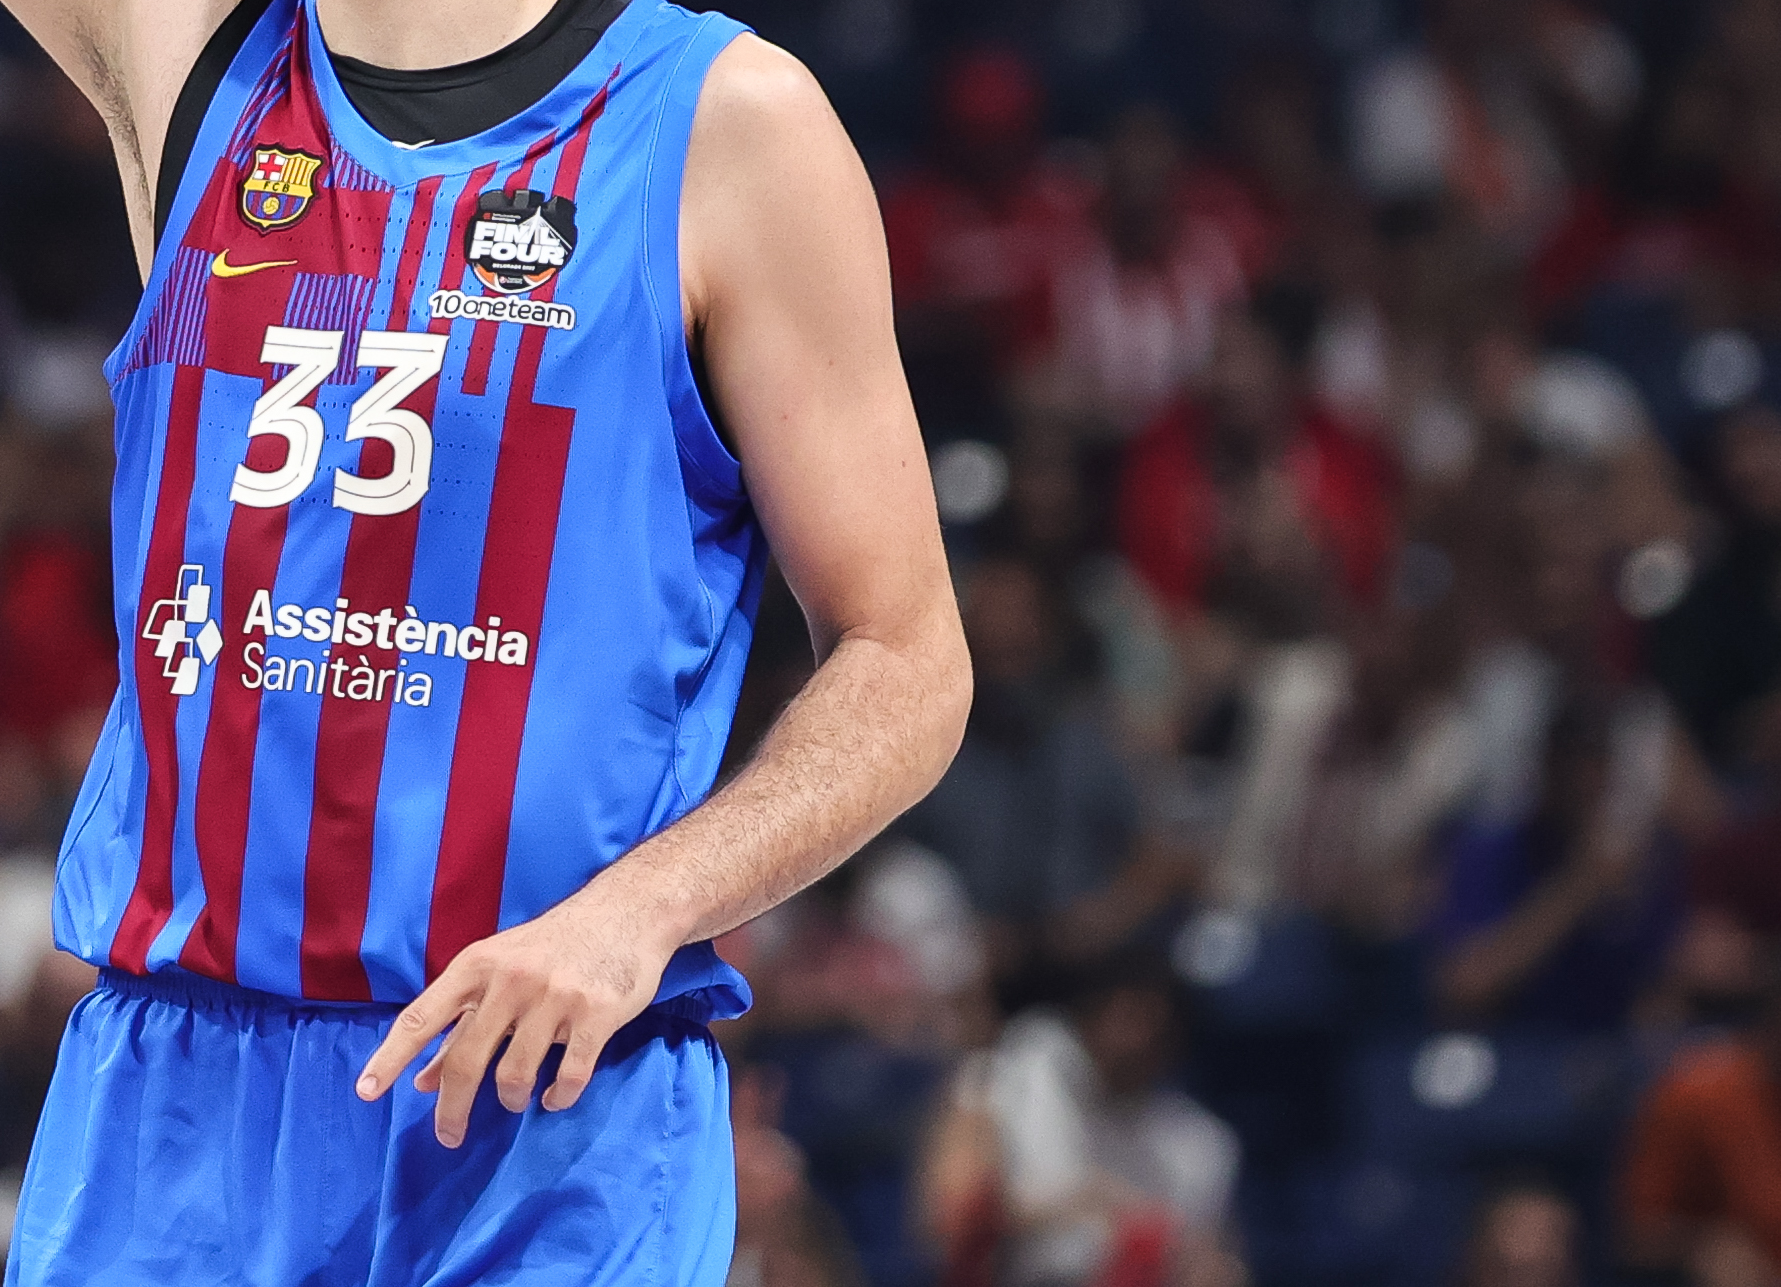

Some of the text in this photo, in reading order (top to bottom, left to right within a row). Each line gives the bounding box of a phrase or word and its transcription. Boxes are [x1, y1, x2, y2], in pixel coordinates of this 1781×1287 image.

[262, 181, 291, 193] FCB
[469, 239, 566, 266] FOUR
[229, 325, 451, 517] 33
[241, 588, 530, 667] Assistència
[239, 641, 435, 708] Sanitària
